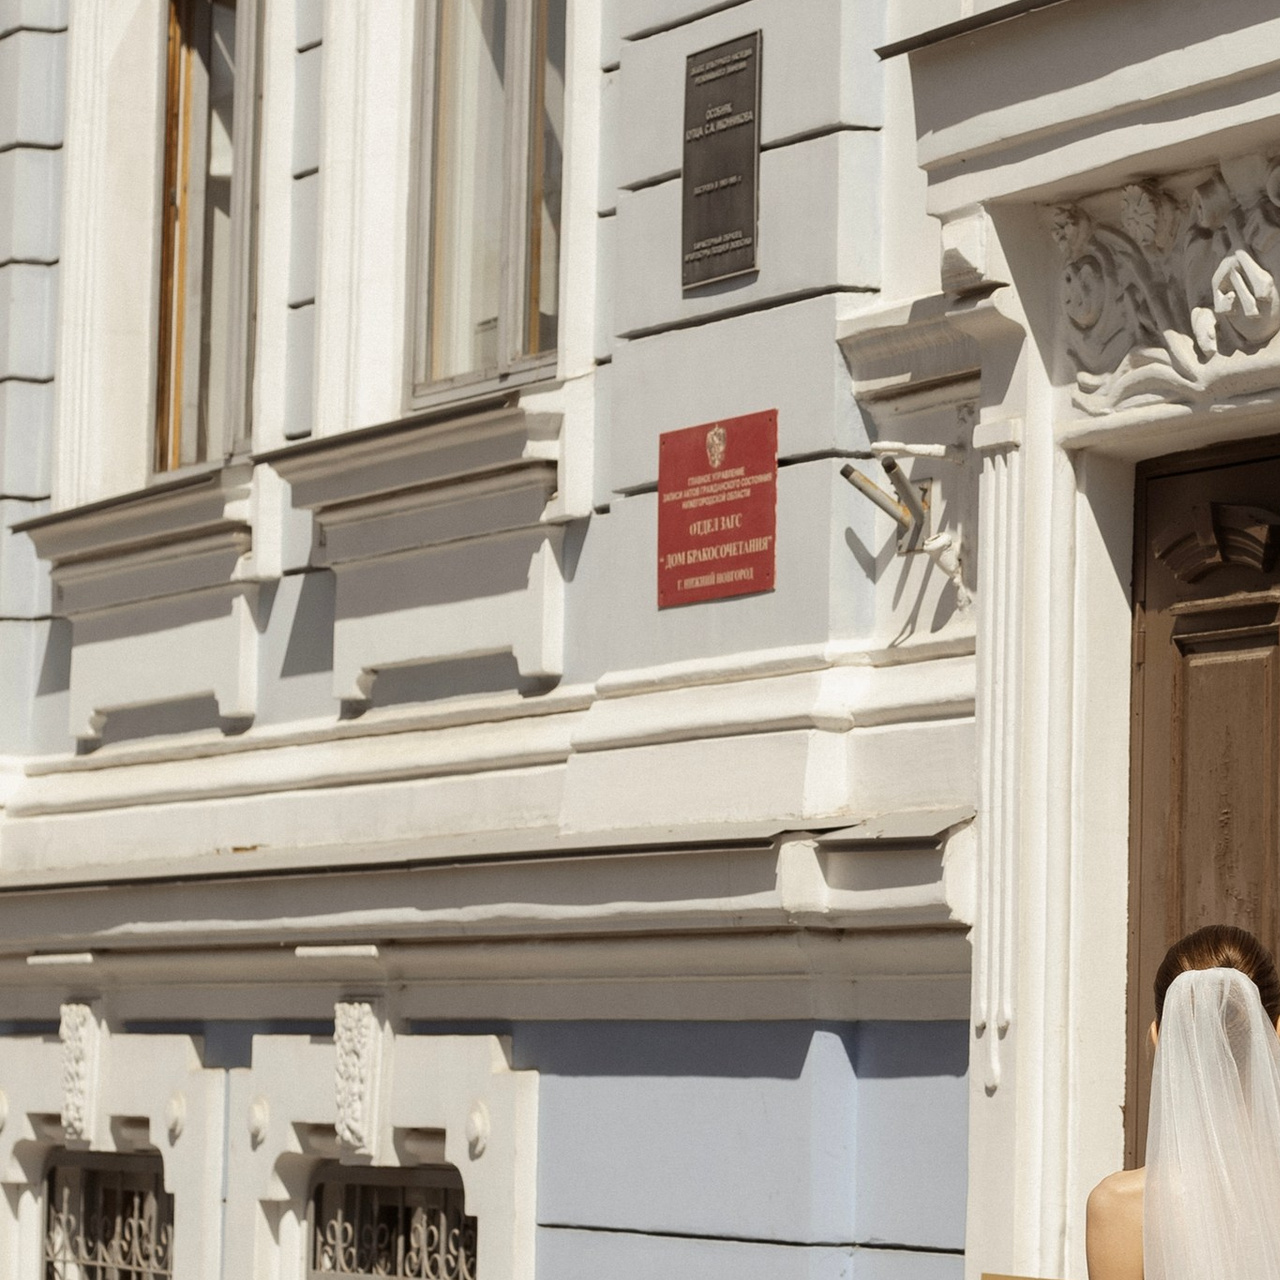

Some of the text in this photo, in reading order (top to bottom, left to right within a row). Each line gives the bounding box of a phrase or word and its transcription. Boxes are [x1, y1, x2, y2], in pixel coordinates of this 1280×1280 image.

[689, 513, 742, 536] ОТДЕЛ ЗАГС
[716, 567, 754, 584] НОВГОРОД
